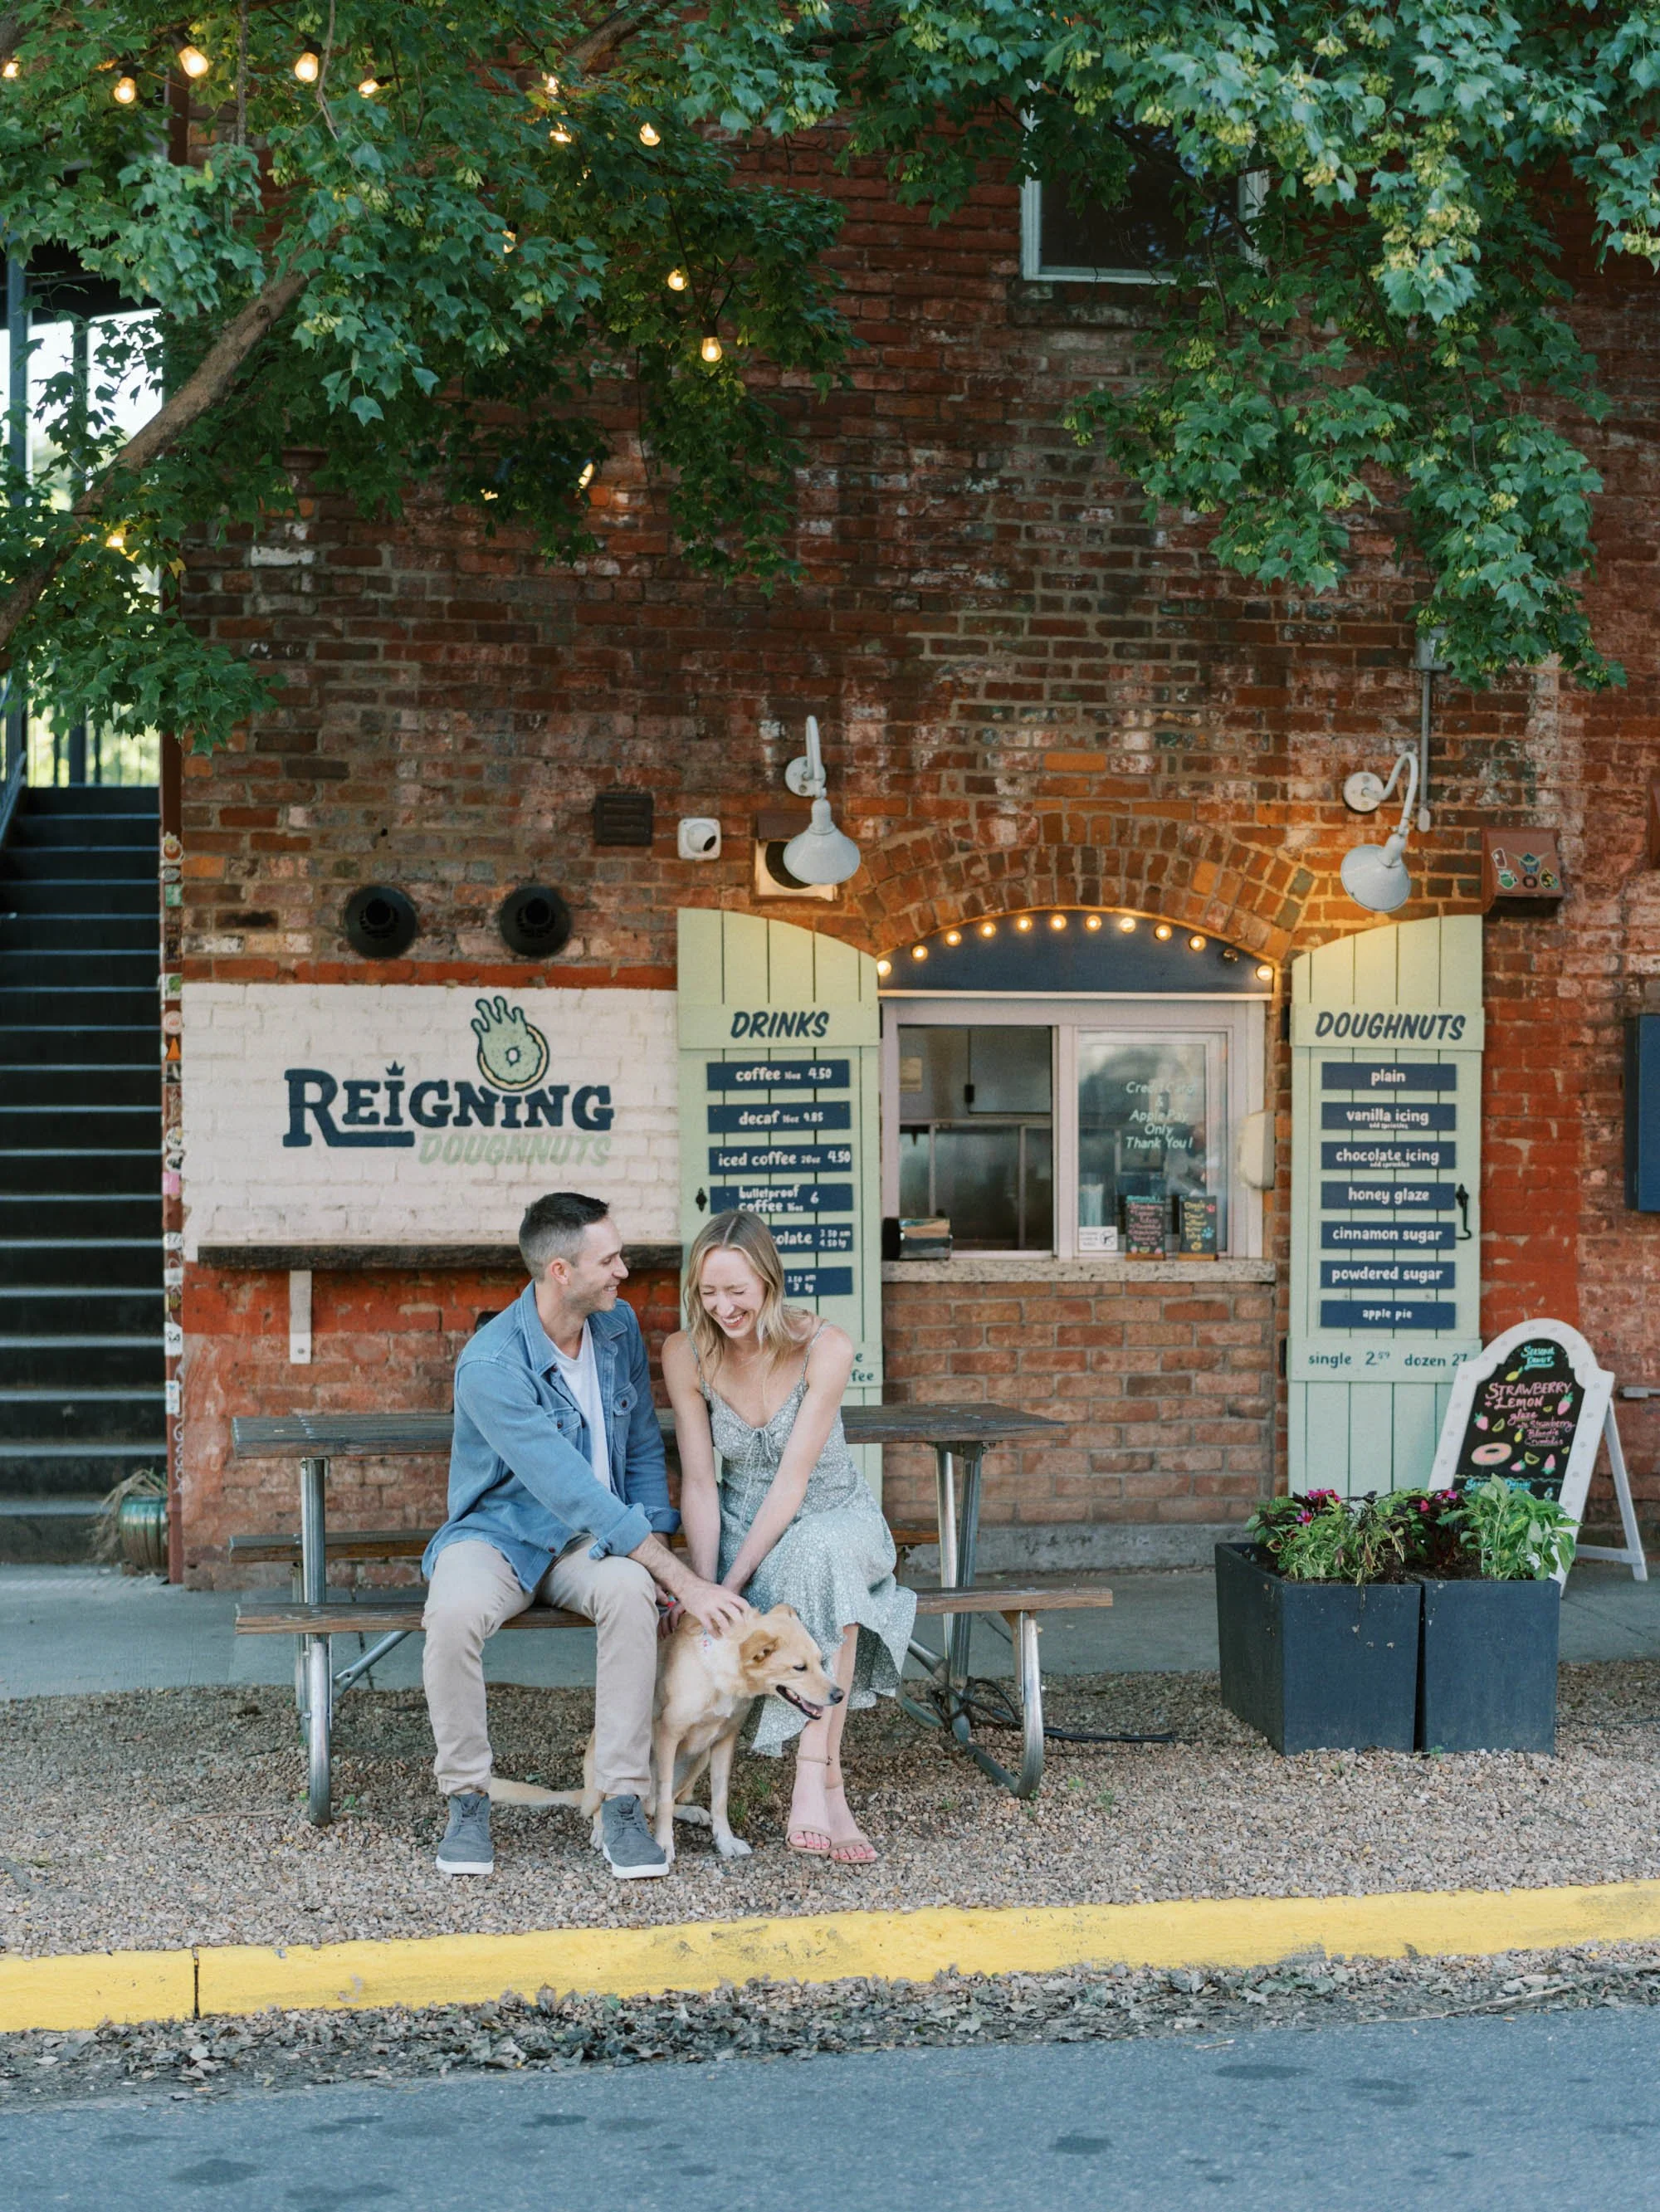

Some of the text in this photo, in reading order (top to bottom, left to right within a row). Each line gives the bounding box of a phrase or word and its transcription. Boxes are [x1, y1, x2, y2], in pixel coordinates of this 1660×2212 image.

[730, 1011, 830, 1038] DRINKS
[1315, 1011, 1466, 1040] DOUGHNUTS
[735, 1067, 781, 1082] coffee
[808, 1067, 832, 1079] 4.50
[1371, 1068, 1405, 1086] plain
[282, 1068, 615, 1148] REIGNING
[1129, 1109, 1189, 1124] Apple Pay
[739, 1110, 780, 1126] decaf
[1346, 1108, 1428, 1126] vanilla icing
[1144, 1122, 1174, 1137] Only
[418, 1133, 613, 1165] DOUGHNUTS
[1126, 1136, 1162, 1149] Thank
[719, 1152, 747, 1167] iced
[751, 1151, 797, 1165] coffee
[828, 1150, 851, 1163] 4.50
[1335, 1148, 1440, 1166] chocolate icing
[739, 1184, 799, 1202] bulletproof
[810, 1192, 819, 1204] 6
[1348, 1187, 1429, 1204] honey glaze
[739, 1200, 783, 1212] coffee
[1332, 1227, 1443, 1243] cinnamon sugar
[1331, 1266, 1443, 1284] powdered sugar
[1362, 1309, 1413, 1320] apple pie
[1308, 1352, 1351, 1368] single
[1404, 1354, 1446, 1367] dozen
[1485, 1381, 1571, 1399] STRAWBERRY
[1495, 1395, 1544, 1410] LEMON
